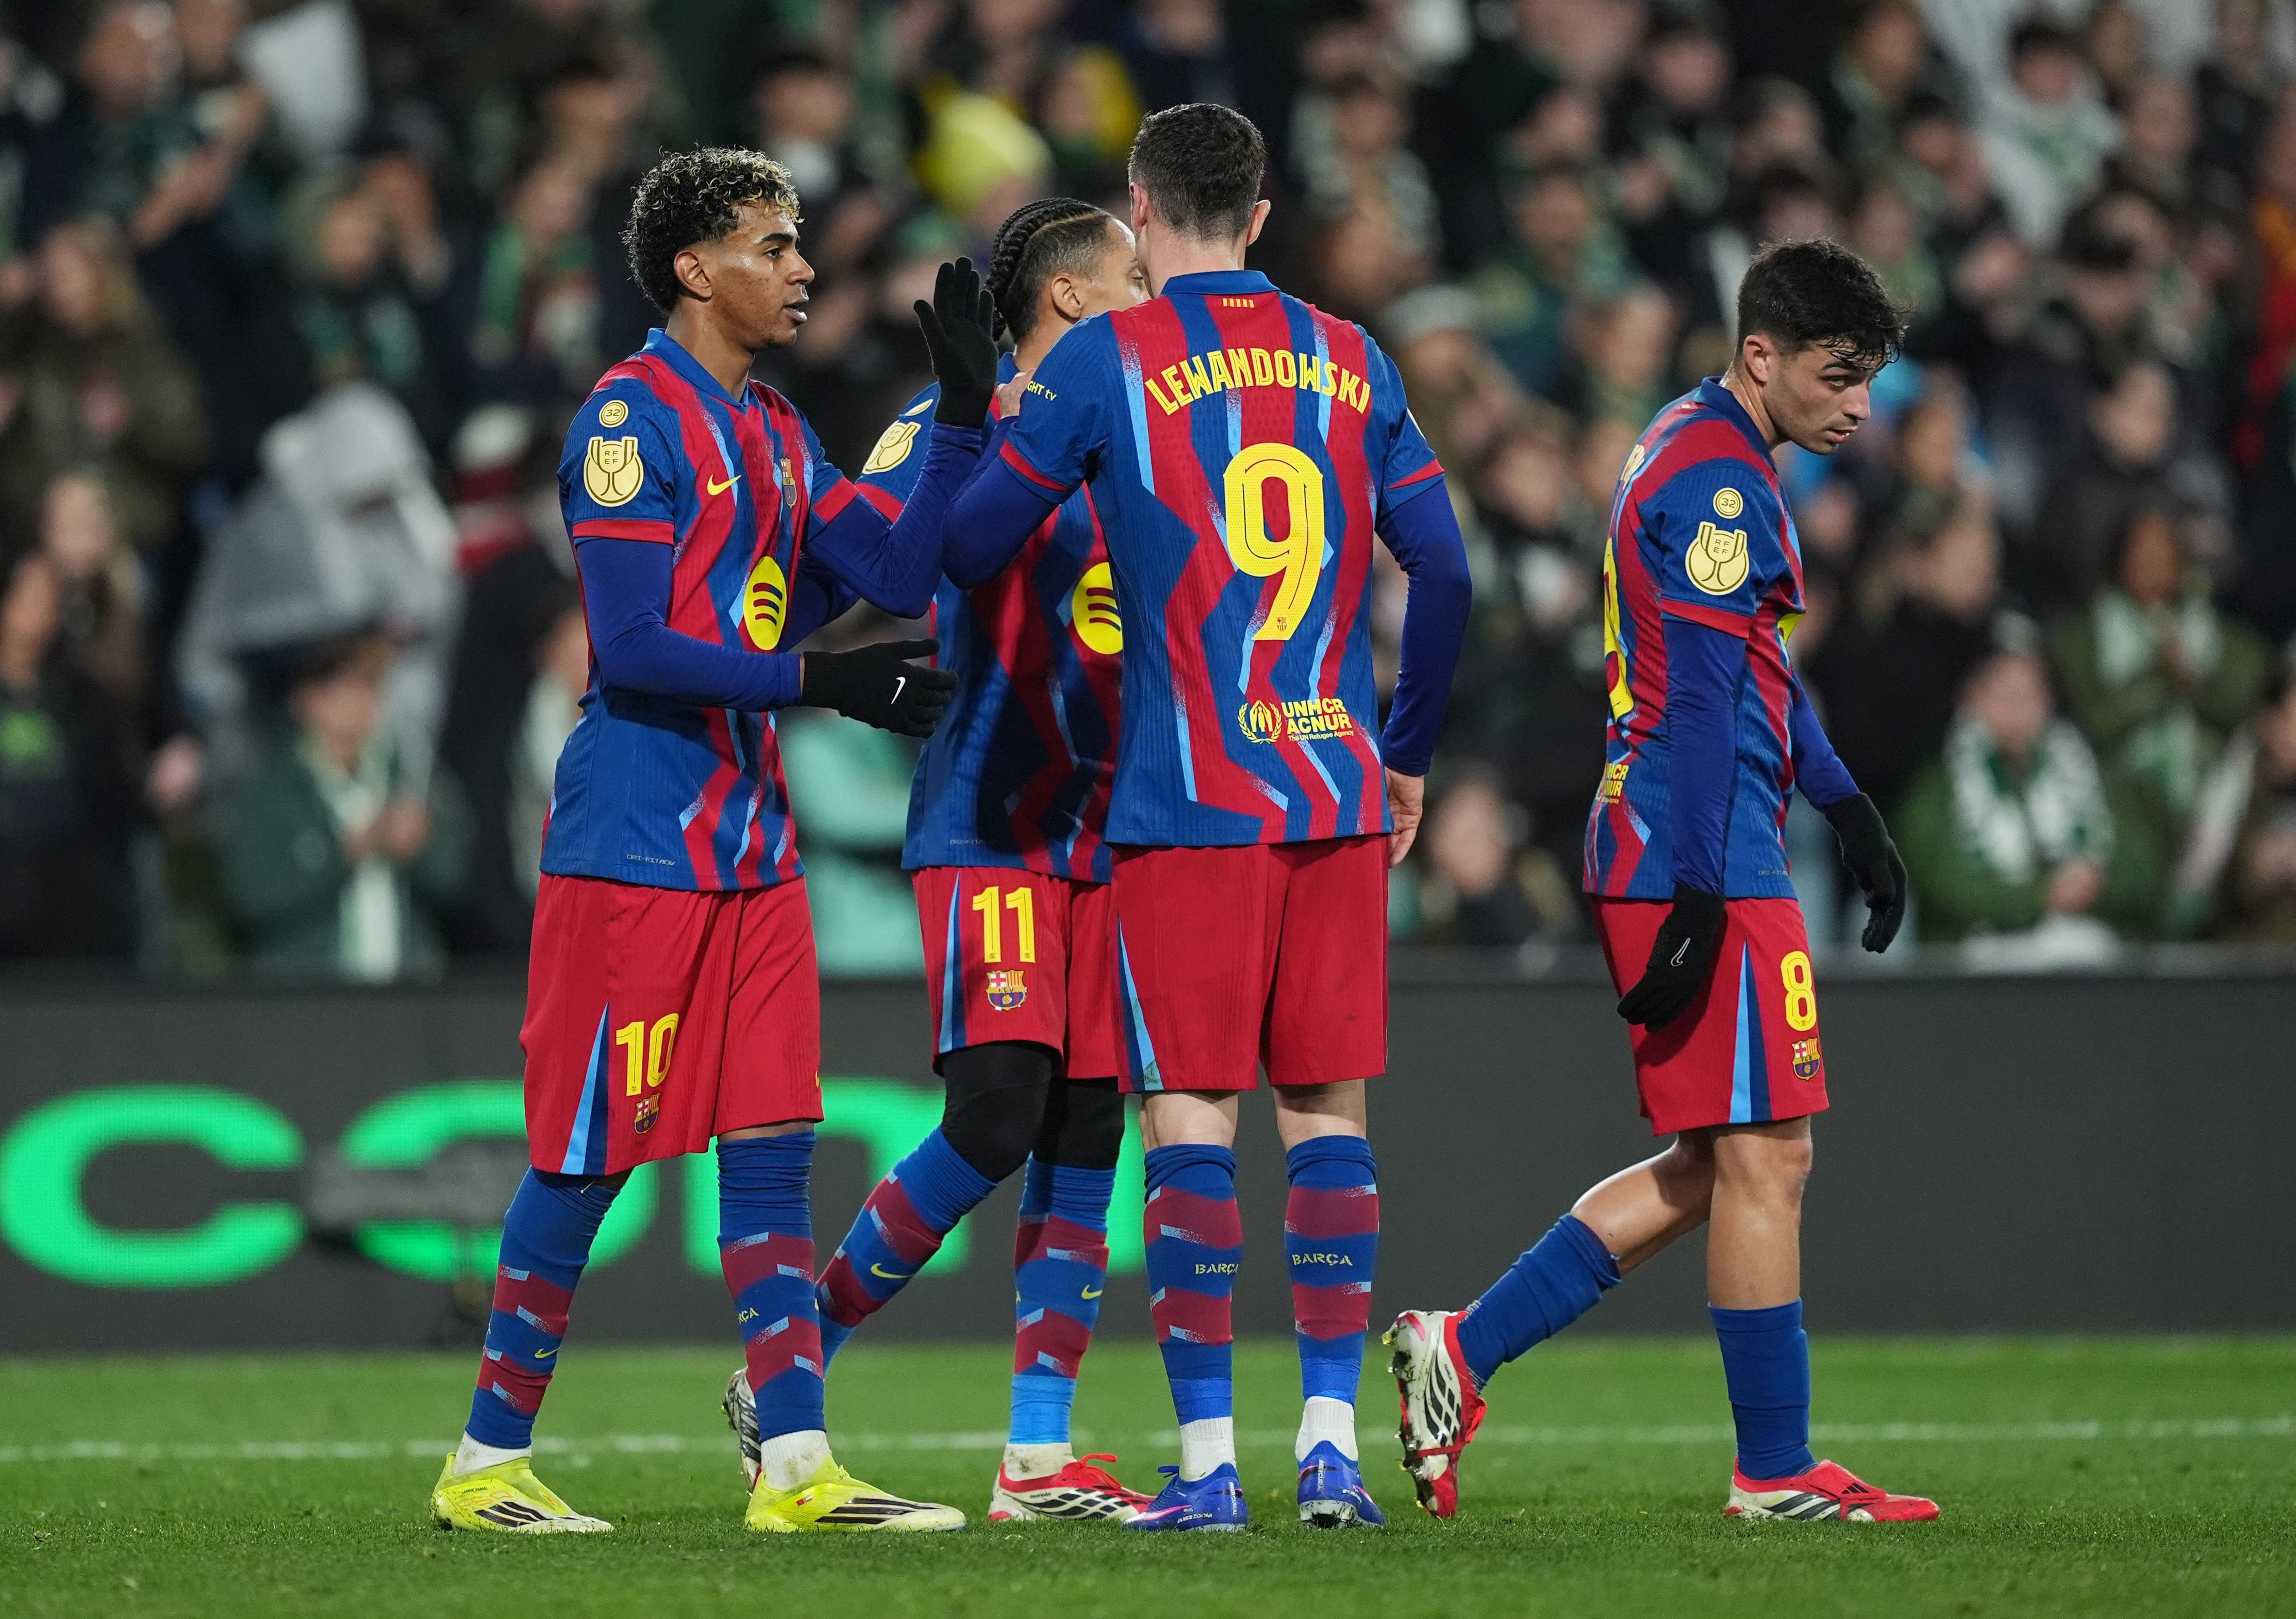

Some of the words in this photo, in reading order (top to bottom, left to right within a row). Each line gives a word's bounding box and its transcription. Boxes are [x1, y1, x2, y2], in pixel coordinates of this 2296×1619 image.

[1144, 348, 1371, 416] LEWANDOWSKI
[1045, 389, 1057, 401] tv
[1721, 498, 1736, 508] 32
[1223, 442, 1325, 640] 9
[1281, 698, 1346, 718] UNHCR
[1287, 714, 1353, 734] ACNUR
[1309, 732, 1333, 740] Refugee
[973, 886, 1036, 963] 11
[1781, 951, 1817, 1031] 8
[616, 1013, 679, 1097] 10
[1292, 1253, 1353, 1266] BARÇA
